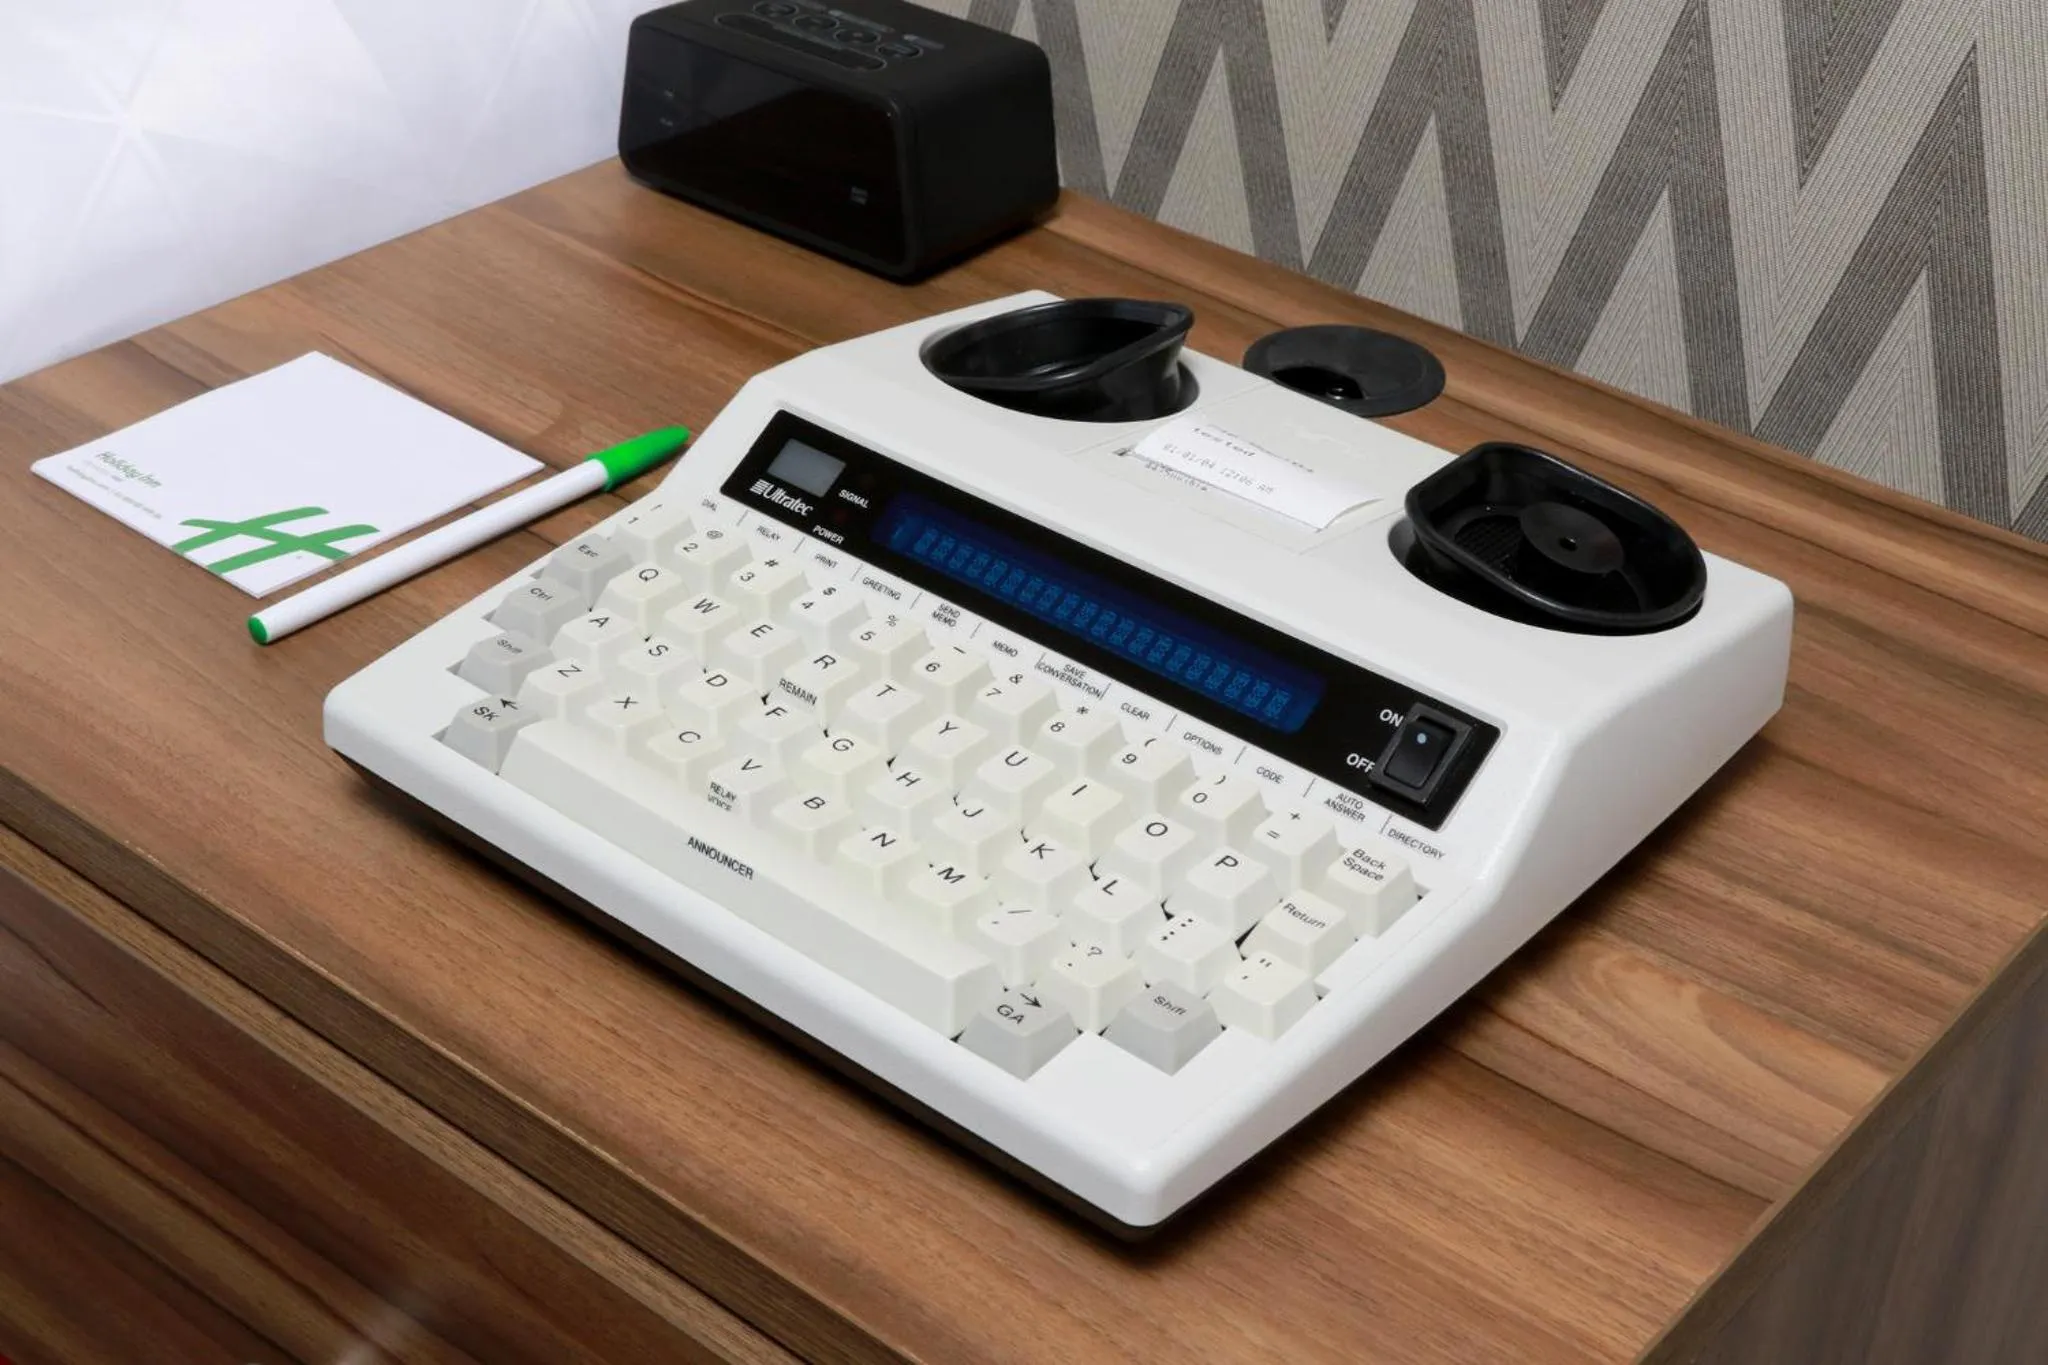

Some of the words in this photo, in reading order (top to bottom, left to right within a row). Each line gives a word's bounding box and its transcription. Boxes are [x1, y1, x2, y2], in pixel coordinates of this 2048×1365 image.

[763, 484, 813, 516] Ultratec
[839, 489, 870, 509] SIGNAL
[172, 507, 380, 574] H
[756, 525, 781, 541] RELAY
[813, 525, 845, 545] POWER
[577, 543, 600, 558] Esc
[683, 543, 698, 553] 2
[764, 559, 779, 568] #
[815, 553, 839, 569] PRINT
[639, 568, 659, 582] Q
[740, 572, 755, 582] 3
[530, 586, 553, 601] Ctrl
[862, 577, 902, 600] GREETING
[693, 598, 720, 614] W
[801, 600, 815, 610] 4
[938, 603, 961, 618] SEND
[589, 615, 610, 628] A
[932, 611, 957, 628] MEMO
[751, 624, 773, 638] E
[860, 631, 876, 641] 5
[648, 644, 669, 657] S
[993, 640, 1018, 658] MEMO
[813, 655, 836, 669] R
[925, 662, 940, 673] 6
[557, 664, 583, 678] Z
[1009, 673, 1023, 685] &
[1063, 663, 1088, 679] SAVE
[706, 674, 728, 687] D
[1037, 662, 1100, 698] CONVERSATION
[778, 678, 817, 705] REMAIN
[876, 684, 897, 697] T
[985, 688, 1001, 698] 7
[614, 696, 637, 709] X
[473, 705, 498, 721] SK
[765, 706, 787, 719] F
[1120, 702, 1150, 721] CLEAR
[1379, 709, 1404, 727] ON
[939, 721, 958, 735] Y
[1050, 721, 1065, 732] 8
[679, 731, 700, 743] C
[832, 738, 854, 752] G
[1183, 732, 1223, 756] OPTIONS
[741, 759, 762, 772] V
[1005, 751, 1028, 767] U
[1122, 753, 1137, 765] 9
[1346, 753, 1375, 773] OFF
[896, 771, 921, 787] H
[1256, 765, 1285, 785] CODE
[710, 781, 736, 801] RELAY
[804, 796, 826, 809] B
[1337, 792, 1364, 811] AUTO
[962, 808, 984, 818] J
[1324, 799, 1366, 823] ANSWER
[1146, 822, 1168, 836] O
[871, 832, 896, 848] N
[1387, 828, 1446, 860] DIRECTORY
[687, 836, 754, 880] ANNOUNCER
[1030, 843, 1055, 859] K
[1352, 848, 1386, 870] Back
[1214, 855, 1239, 868] P
[1343, 857, 1384, 882] Space
[937, 866, 966, 884] M
[1102, 880, 1118, 896] L
[1283, 902, 1326, 929] Return
[1153, 995, 1187, 1016] Shift
[996, 1003, 1024, 1025] GA
